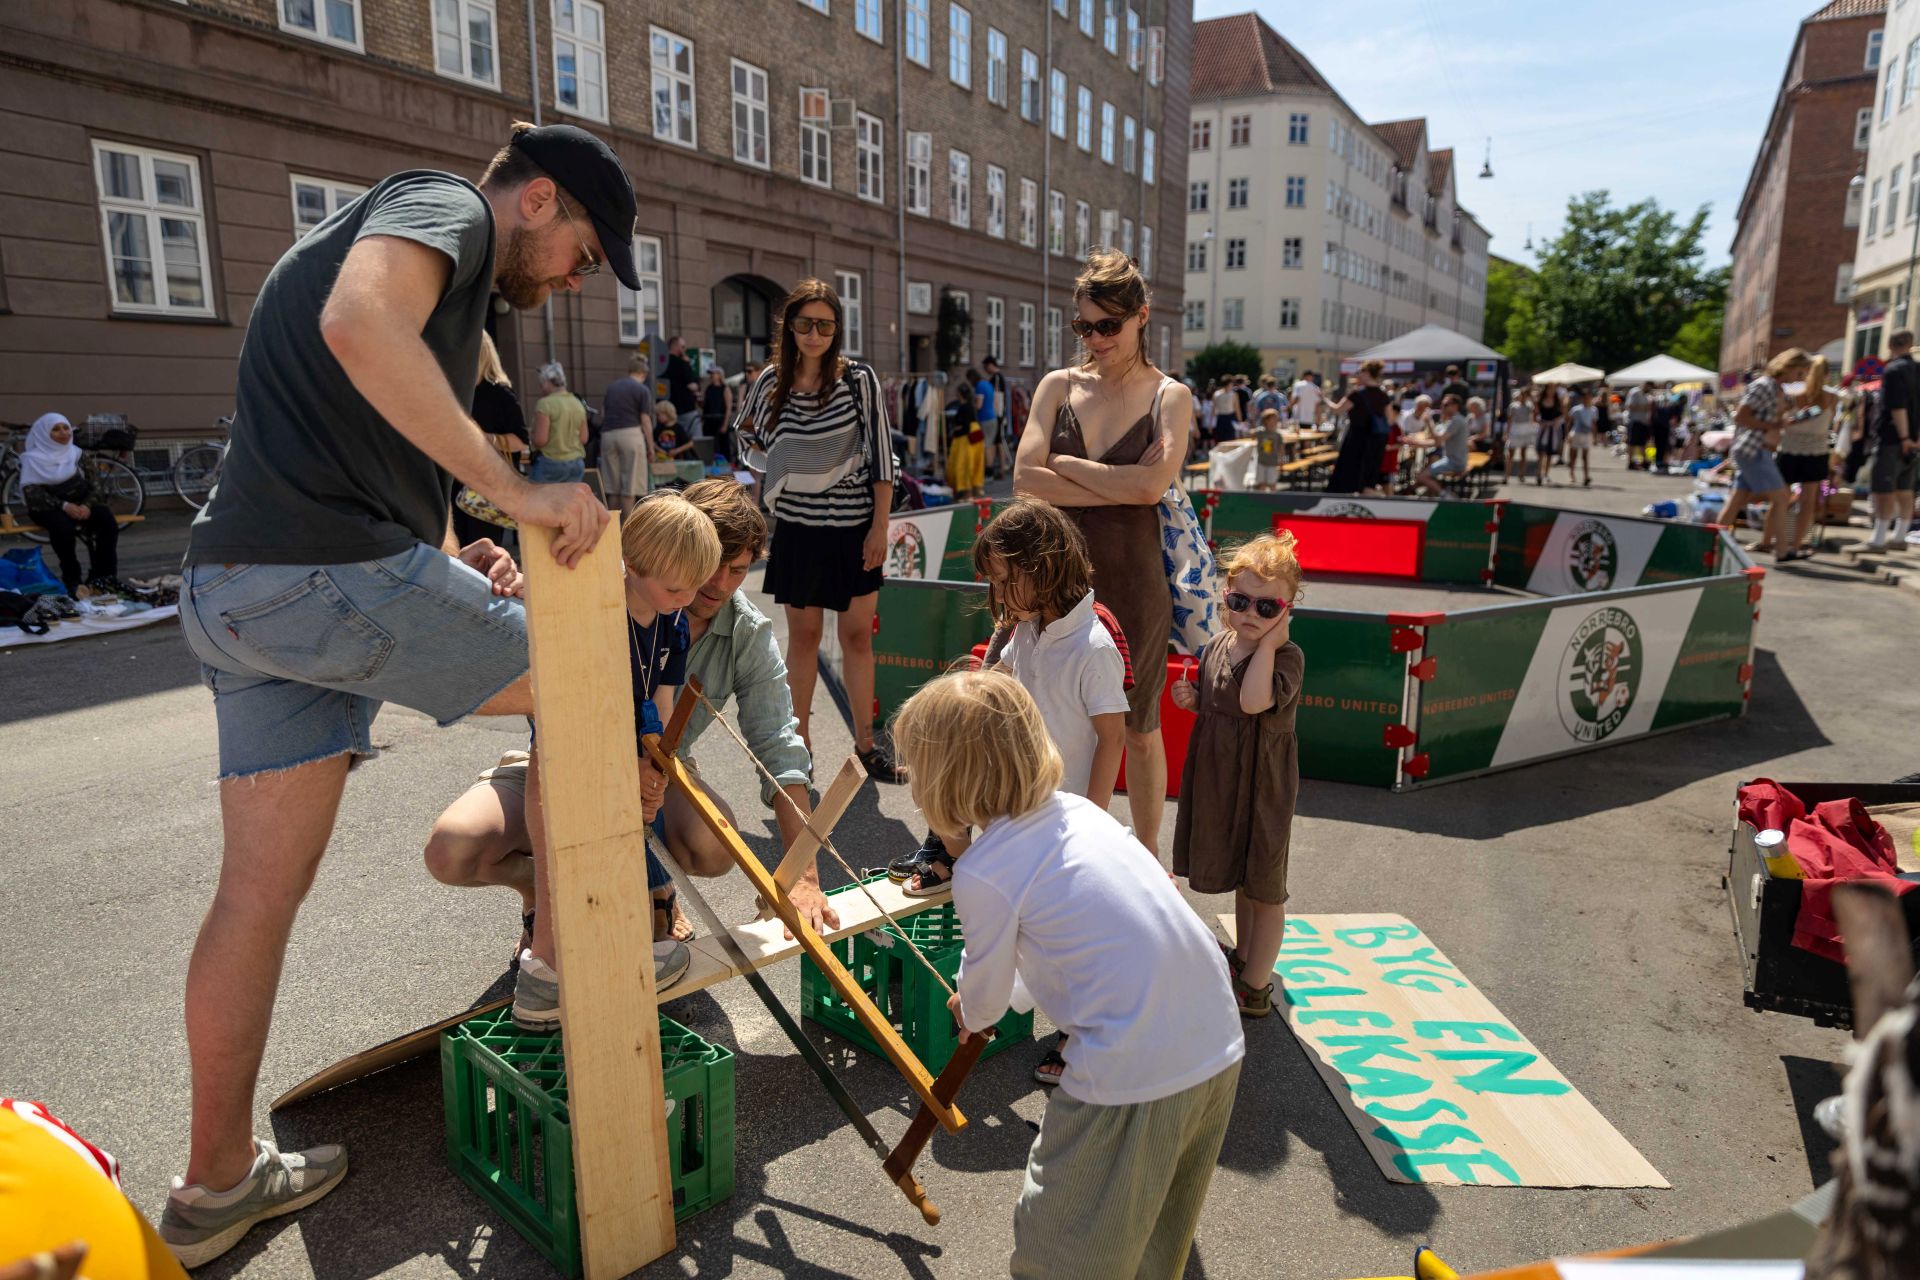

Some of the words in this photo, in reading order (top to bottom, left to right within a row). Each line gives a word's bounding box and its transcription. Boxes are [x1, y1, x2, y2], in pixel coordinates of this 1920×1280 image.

[1341, 699, 1399, 714] UNITED
[1480, 688, 1516, 704] UNITED
[1574, 711, 1621, 738] UNITED
[1333, 924, 1468, 993] BYG
[1412, 1020, 1573, 1096] EN
